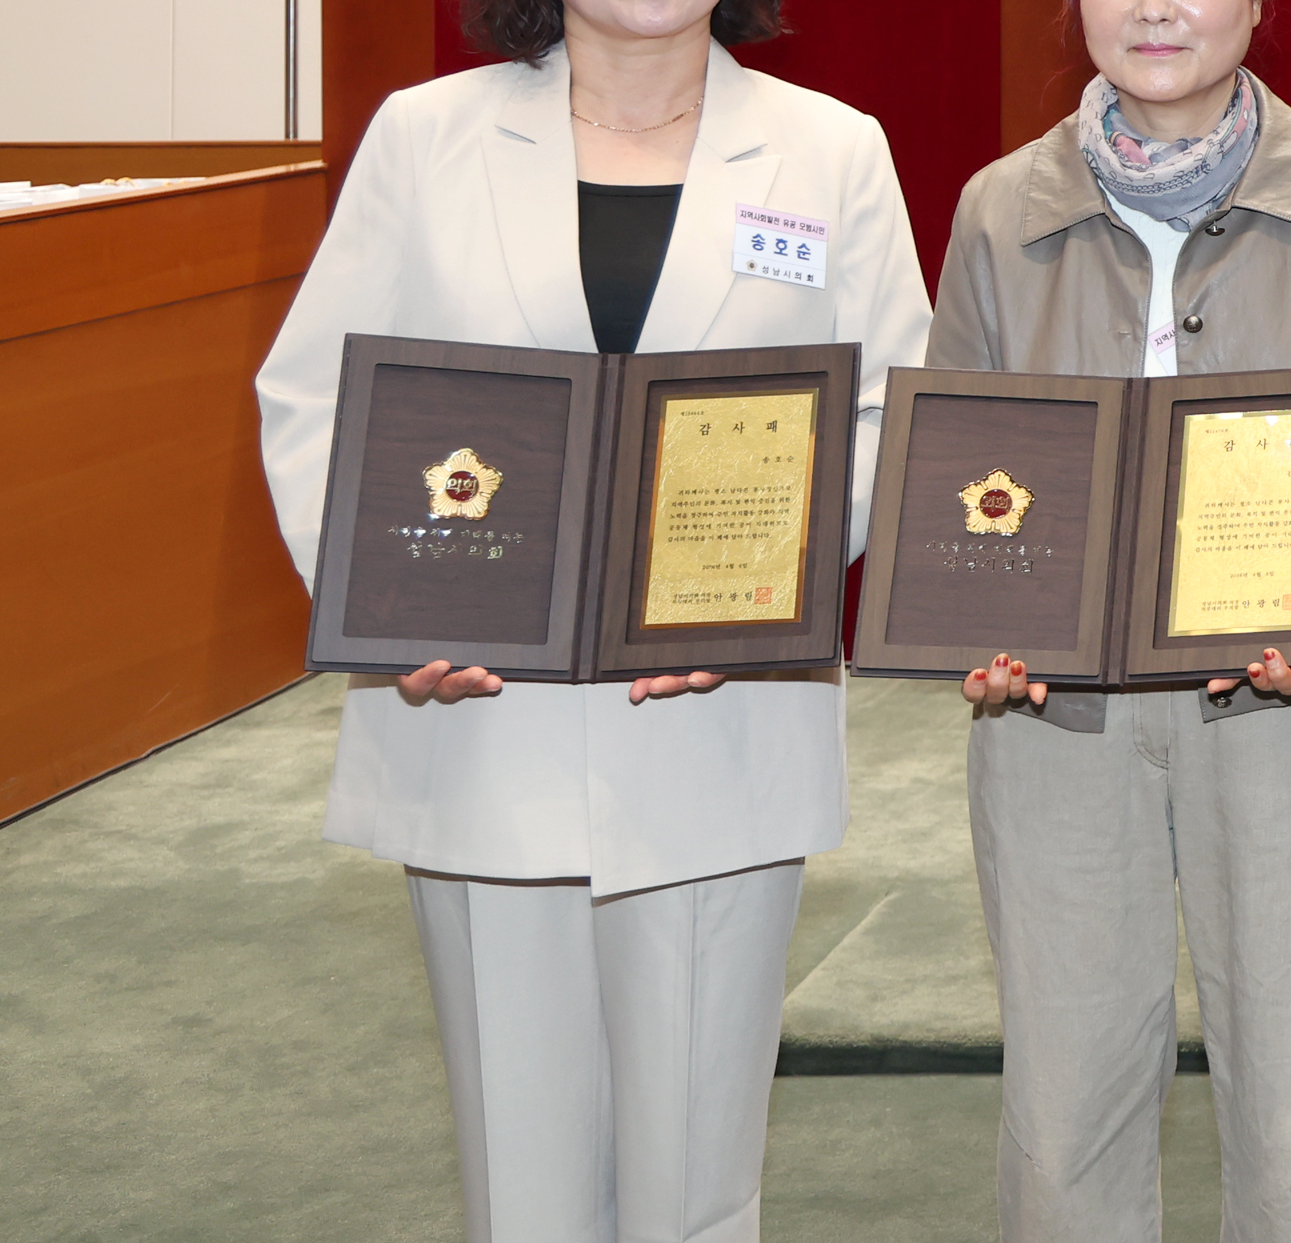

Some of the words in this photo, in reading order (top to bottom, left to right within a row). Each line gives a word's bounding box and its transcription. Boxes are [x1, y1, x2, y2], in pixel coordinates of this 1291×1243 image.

[740, 210, 780, 225] 지역사회발전
[783, 219, 796, 229] 유공
[799, 223, 825, 235] 모범시민
[762, 266, 814, 283] 성남시의회
[446, 478, 477, 494] 의회
